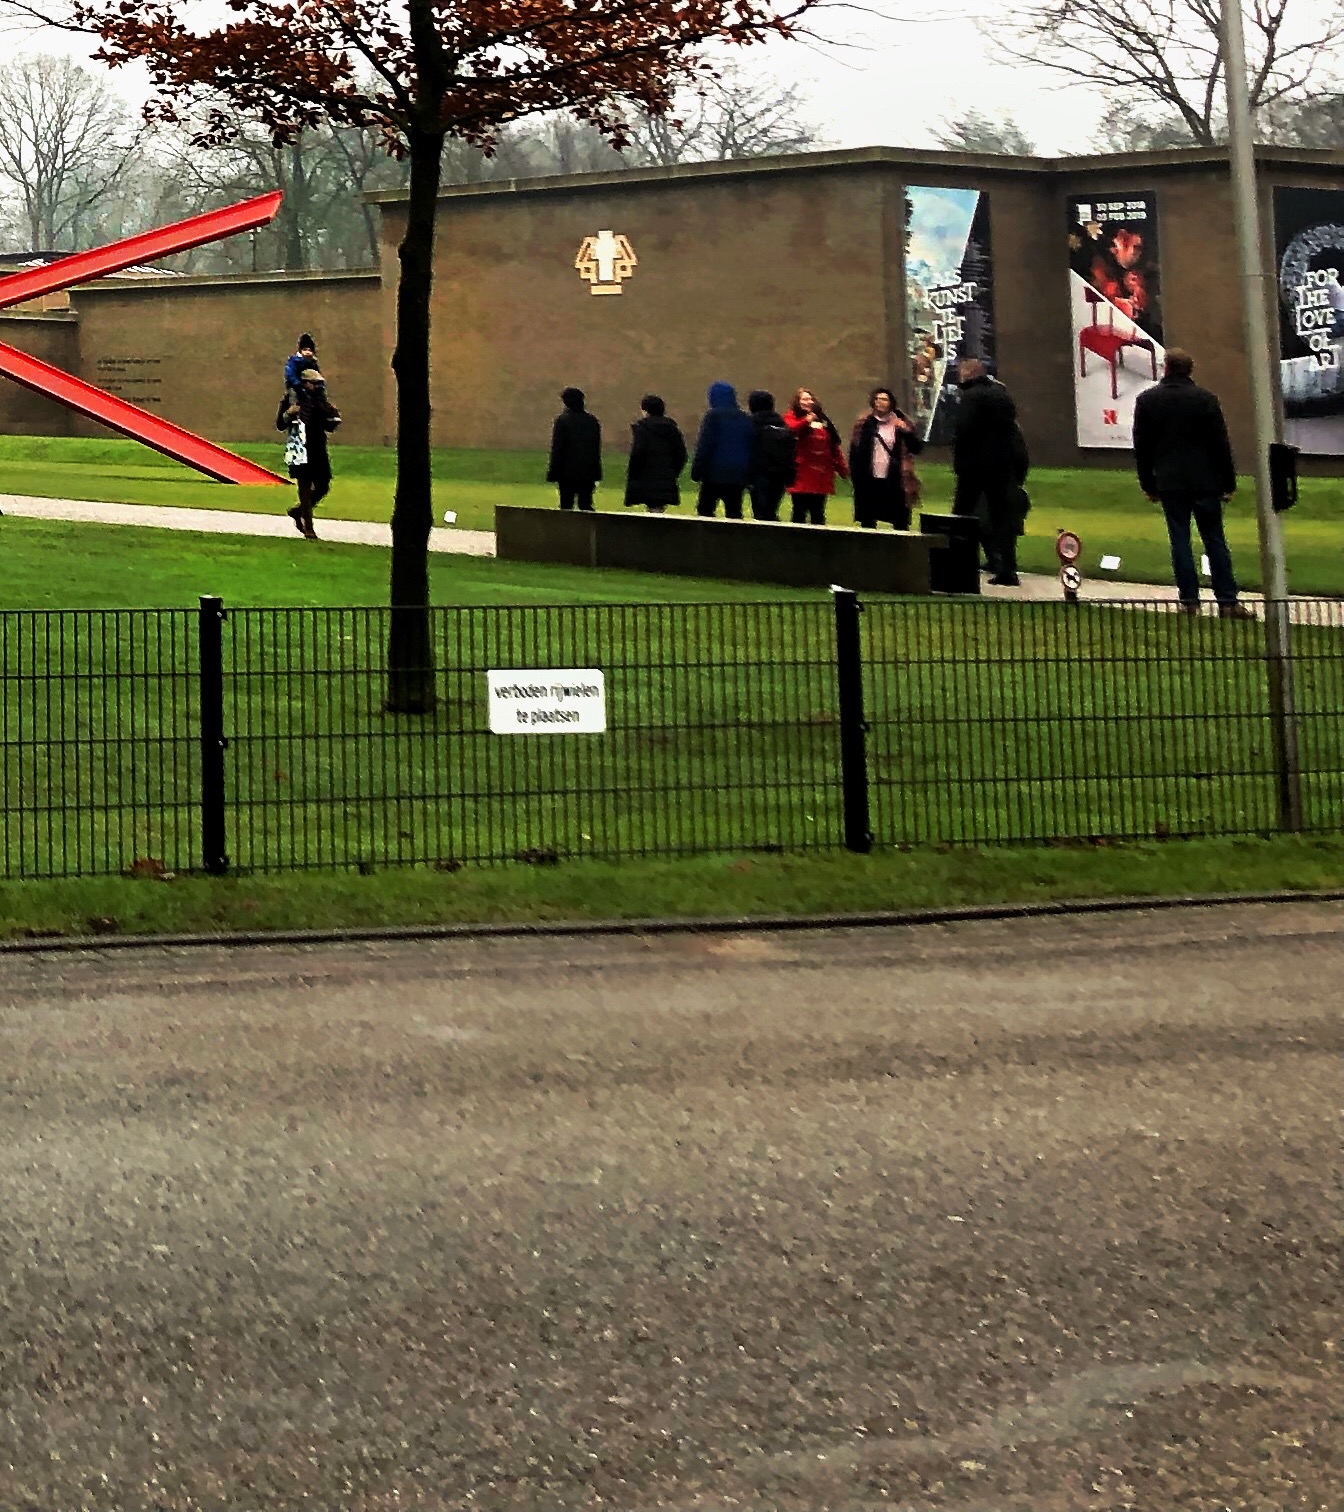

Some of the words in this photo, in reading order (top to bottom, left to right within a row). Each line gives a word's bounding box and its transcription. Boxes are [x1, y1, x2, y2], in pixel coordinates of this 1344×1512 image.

[1305, 268, 1343, 289] FOR
[923, 282, 977, 309] KUNST
[1296, 285, 1330, 308] THE
[1296, 306, 1337, 336] LOVE
[494, 683, 548, 699] verboden
[516, 708, 529, 724] te
[530, 708, 580, 725] plaatsen
